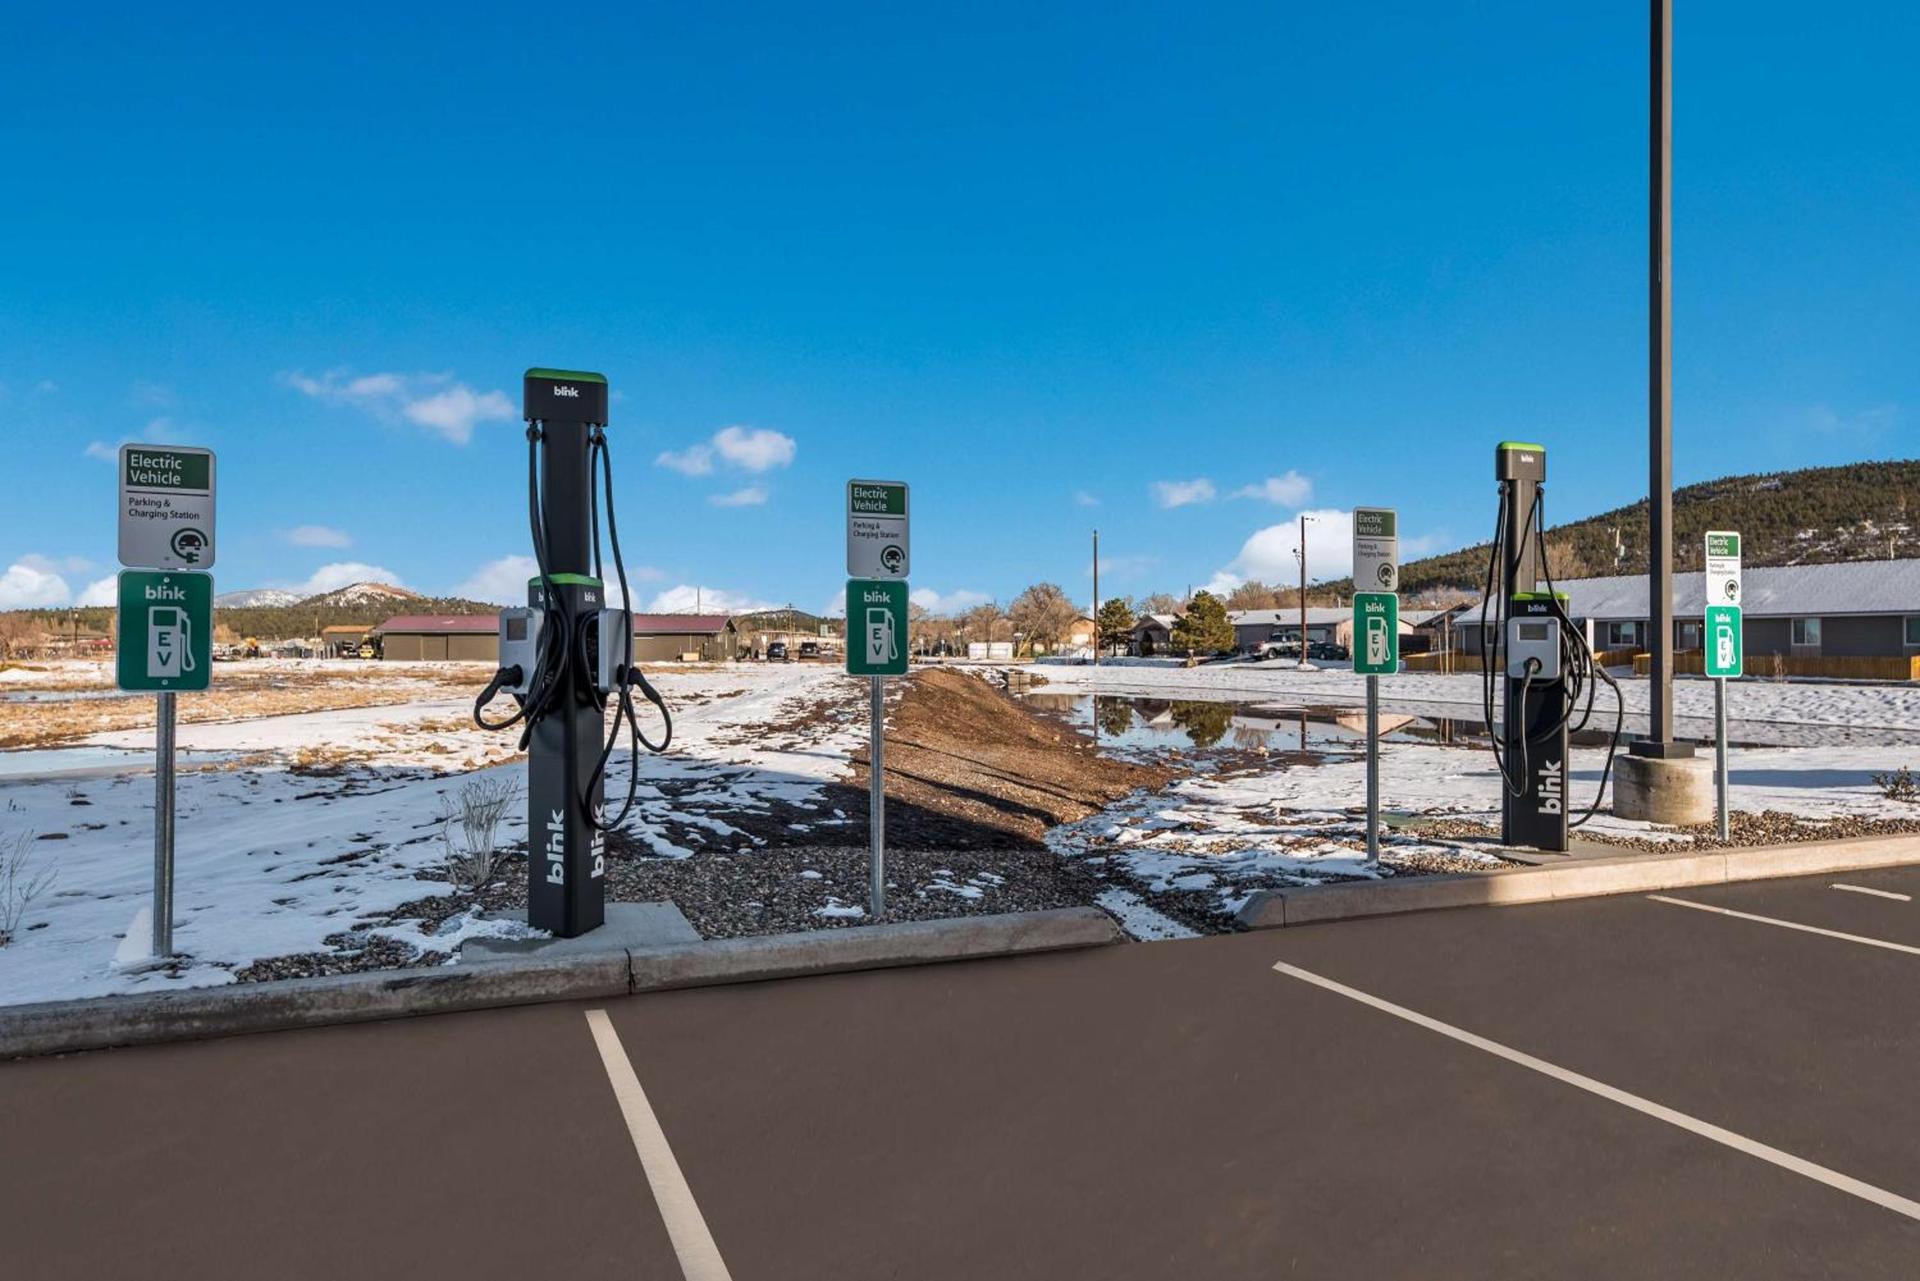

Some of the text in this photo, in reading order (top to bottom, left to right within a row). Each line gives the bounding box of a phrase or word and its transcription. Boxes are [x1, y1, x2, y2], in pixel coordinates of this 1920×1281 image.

[553, 385, 579, 398] blink
[130, 453, 182, 470] Electric
[130, 469, 182, 485] Vehicle
[853, 487, 888, 499] Electric
[128, 497, 171, 509] Parking &
[853, 499, 887, 511] Vehicle
[128, 508, 200, 521] Charging Station
[145, 585, 186, 601] blink
[863, 591, 891, 603] blink
[1365, 602, 1386, 613] blink
[1538, 759, 1561, 815] blink
[546, 808, 564, 885] blink
